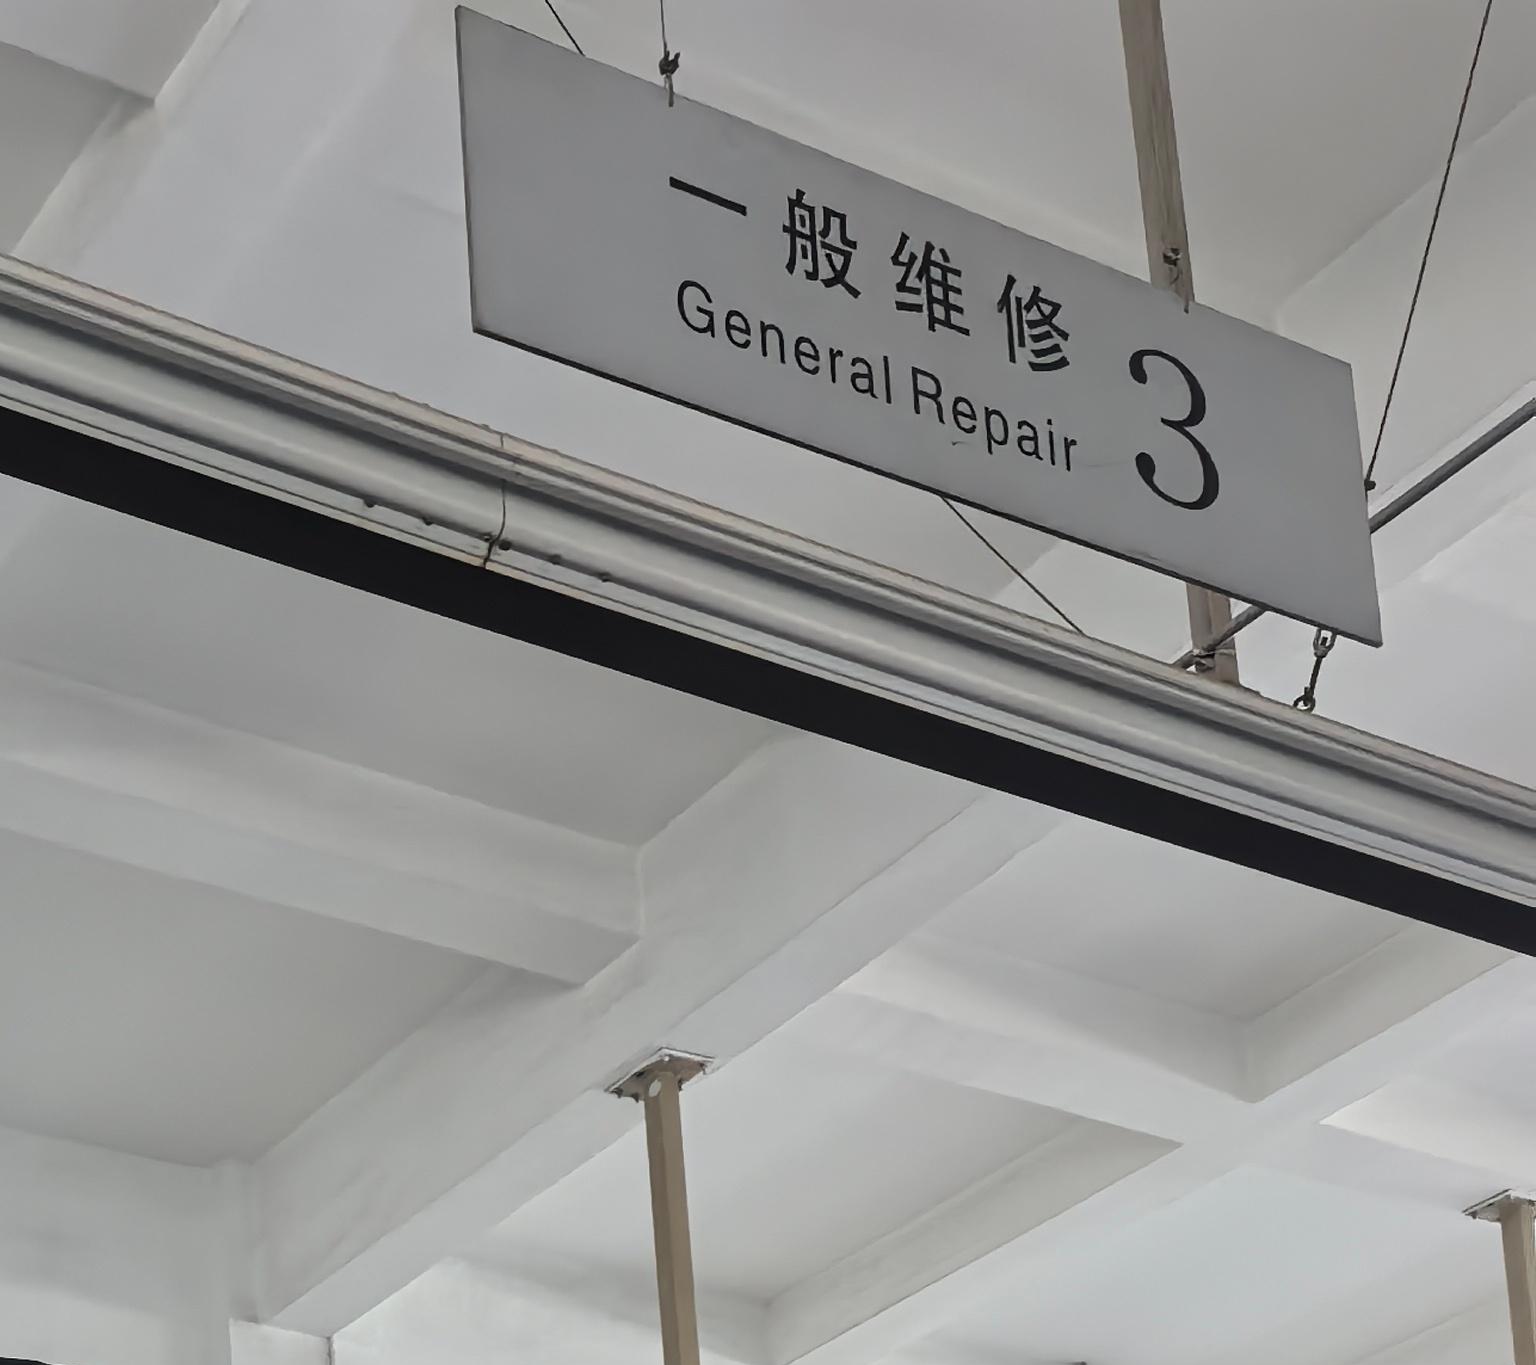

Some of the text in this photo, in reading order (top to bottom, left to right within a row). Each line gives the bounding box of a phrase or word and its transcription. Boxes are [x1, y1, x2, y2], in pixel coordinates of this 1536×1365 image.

[668, 175, 1071, 373] 一般维修
[675, 279, 1079, 475] General Repair
[1127, 348, 1220, 511] 3
